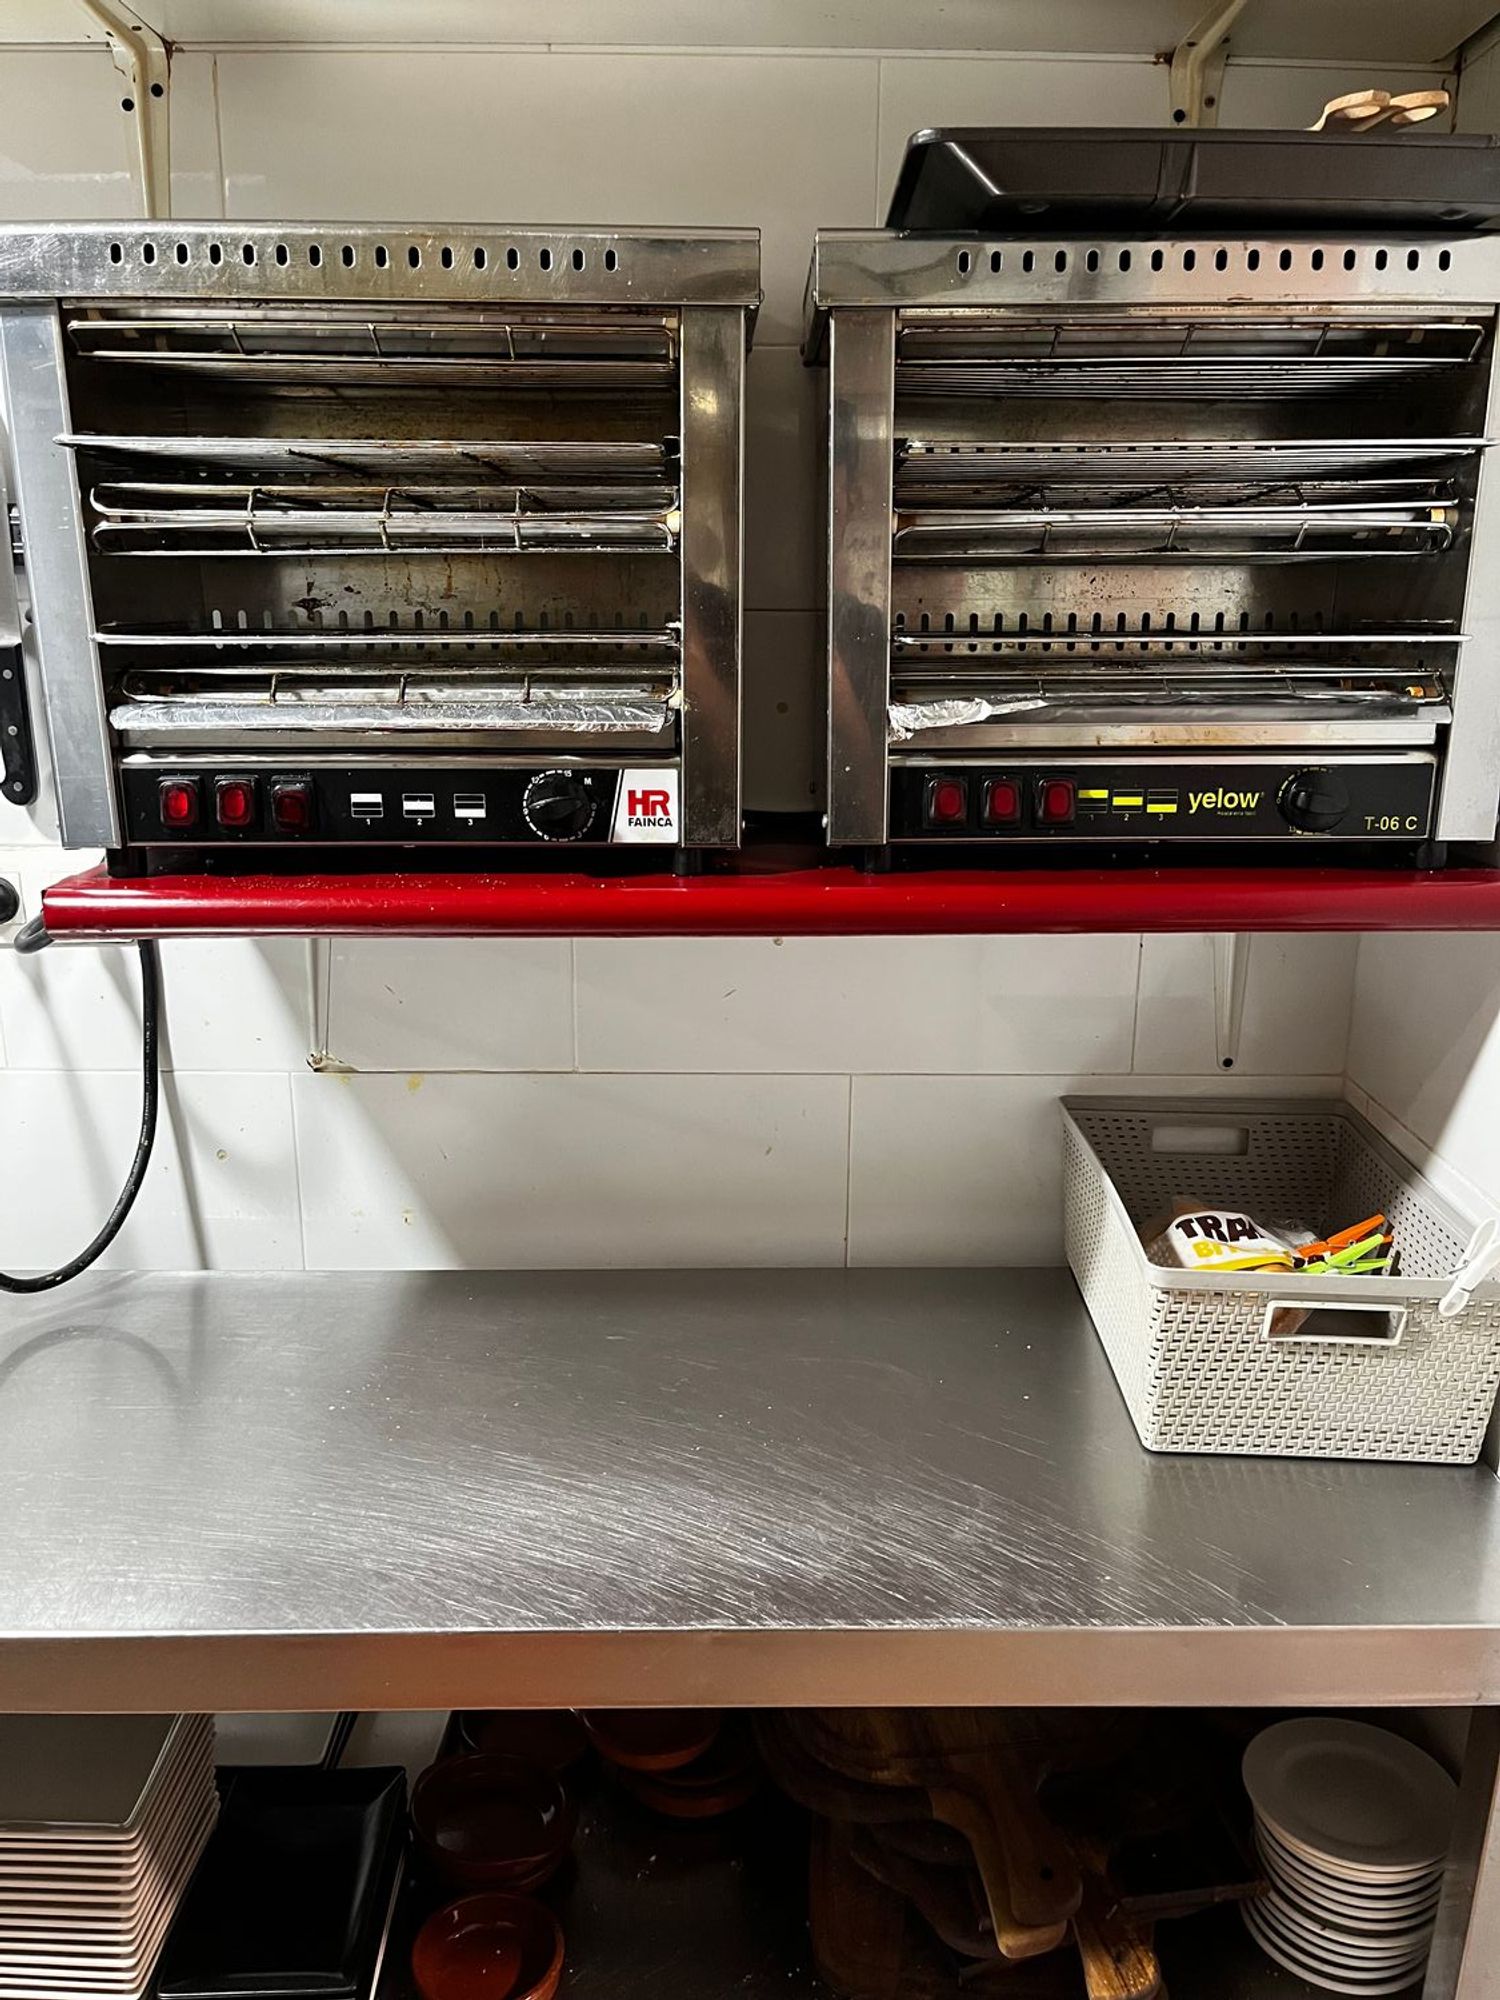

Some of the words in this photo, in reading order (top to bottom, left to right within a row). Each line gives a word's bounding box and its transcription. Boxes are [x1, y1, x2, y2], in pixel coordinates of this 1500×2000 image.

[583, 777, 592, 786] M
[627, 789, 671, 817] HR
[1188, 787, 1260, 814] yelow
[365, 818, 371, 826] 1
[416, 818, 423, 826] 2
[467, 818, 474, 826] 3
[627, 817, 673, 827] FAINCA
[1123, 813, 1130, 822] 2
[1158, 813, 1164, 822] 3
[1364, 816, 1400, 831] T-06
[1405, 816, 1418, 831] C
